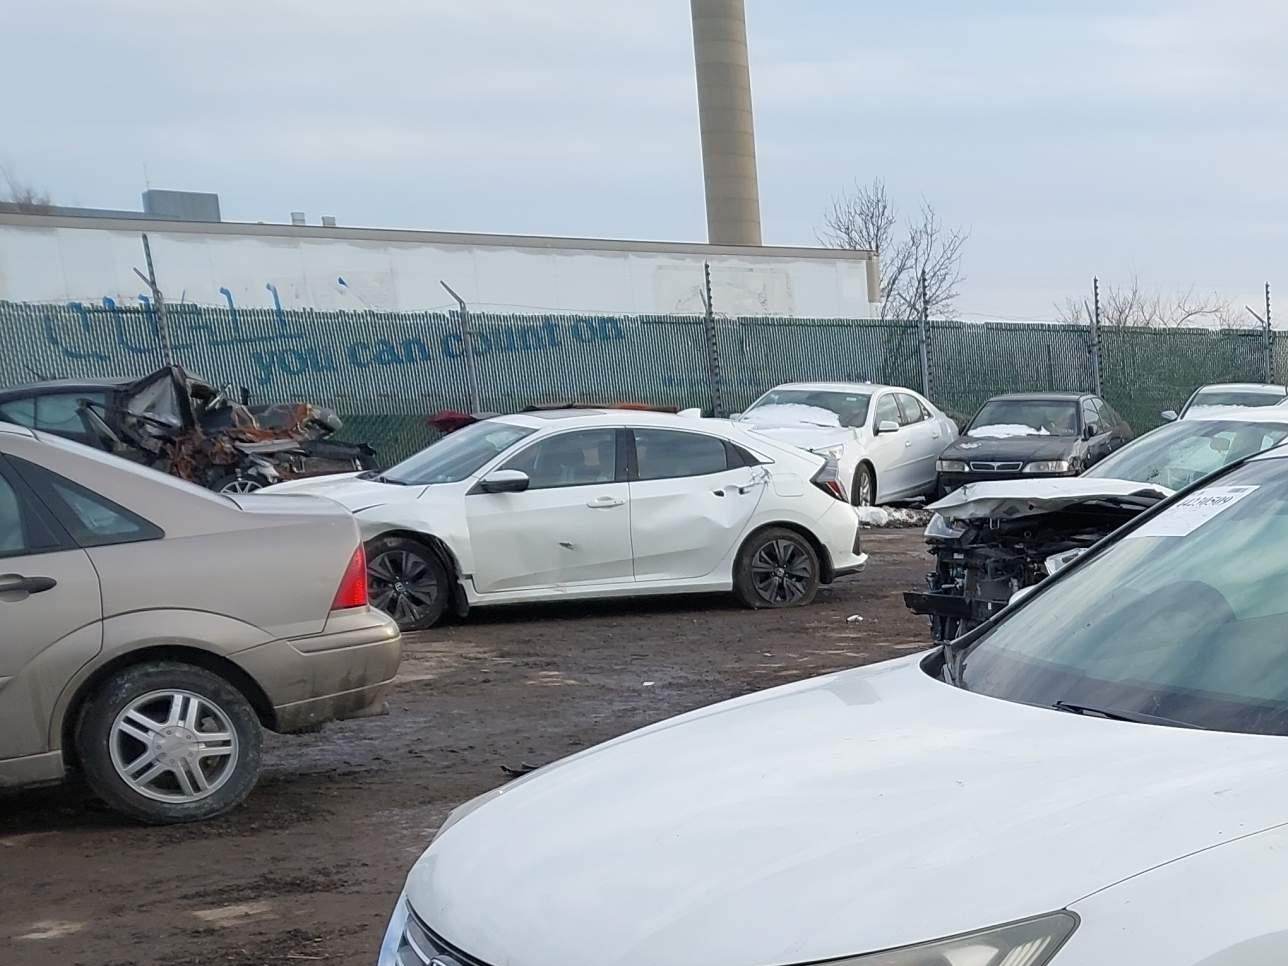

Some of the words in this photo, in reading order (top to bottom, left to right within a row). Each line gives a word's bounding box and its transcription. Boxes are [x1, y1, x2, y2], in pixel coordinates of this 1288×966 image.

[252, 350, 337, 385] you
[349, 337, 430, 368] can
[441, 318, 562, 358] count
[571, 315, 625, 344] on
